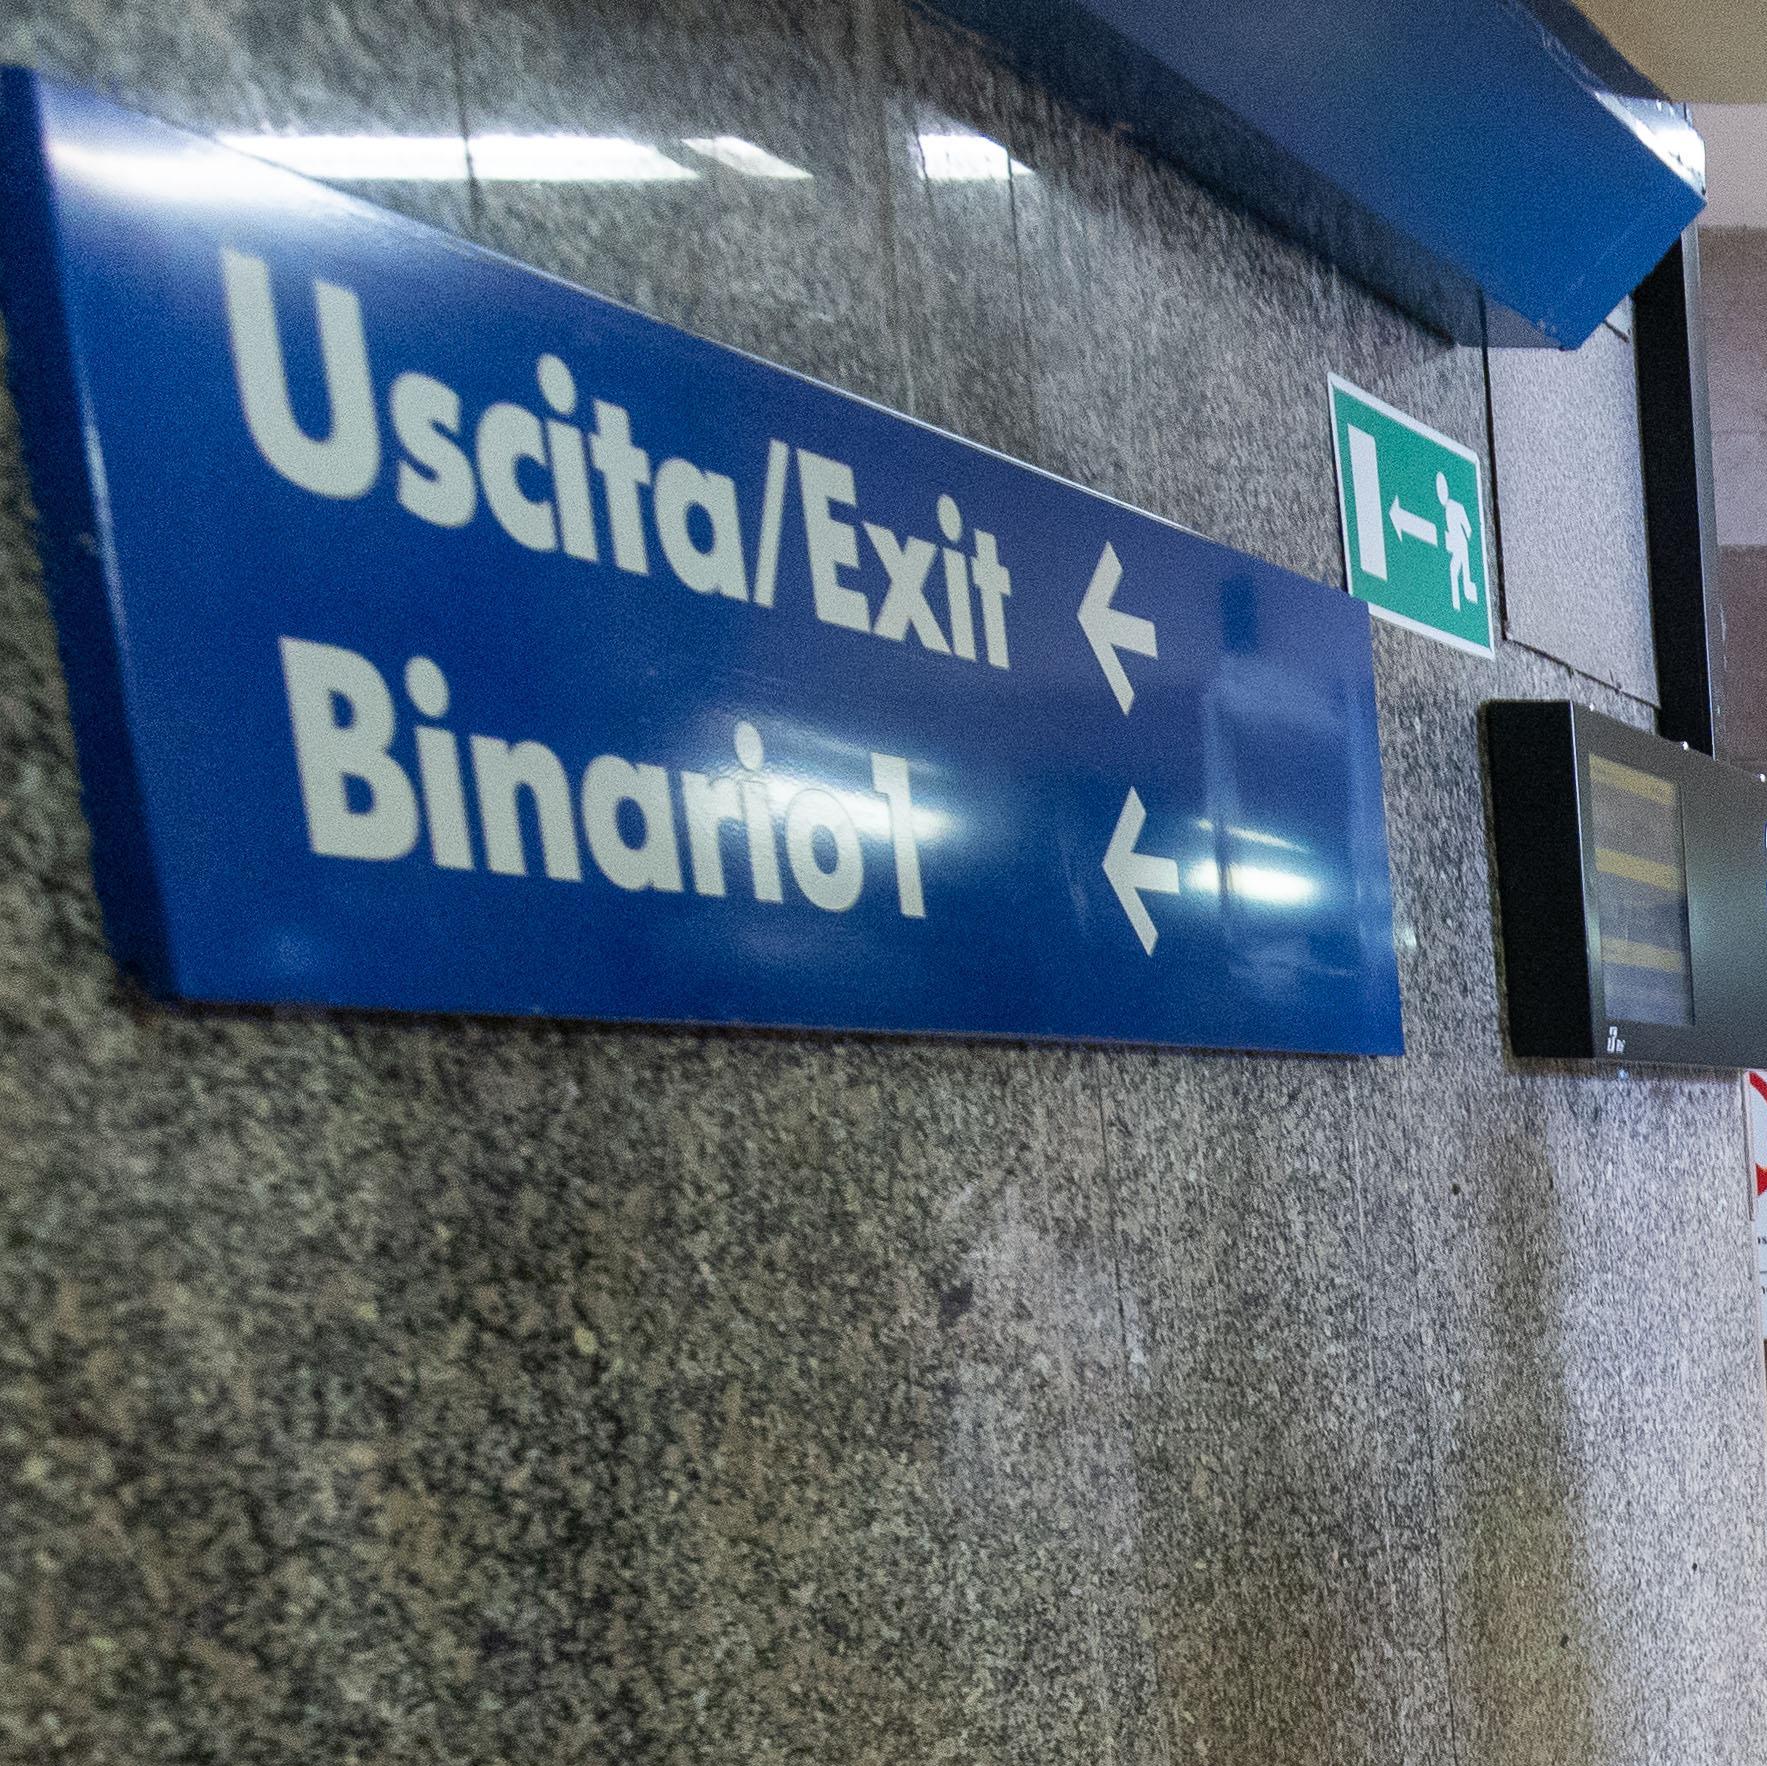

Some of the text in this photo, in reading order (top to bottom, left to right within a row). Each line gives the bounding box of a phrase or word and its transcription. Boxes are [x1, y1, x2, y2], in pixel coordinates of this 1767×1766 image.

[220, 247, 1014, 670] Uscita/Exit
[279, 637, 926, 918] Binario 1
